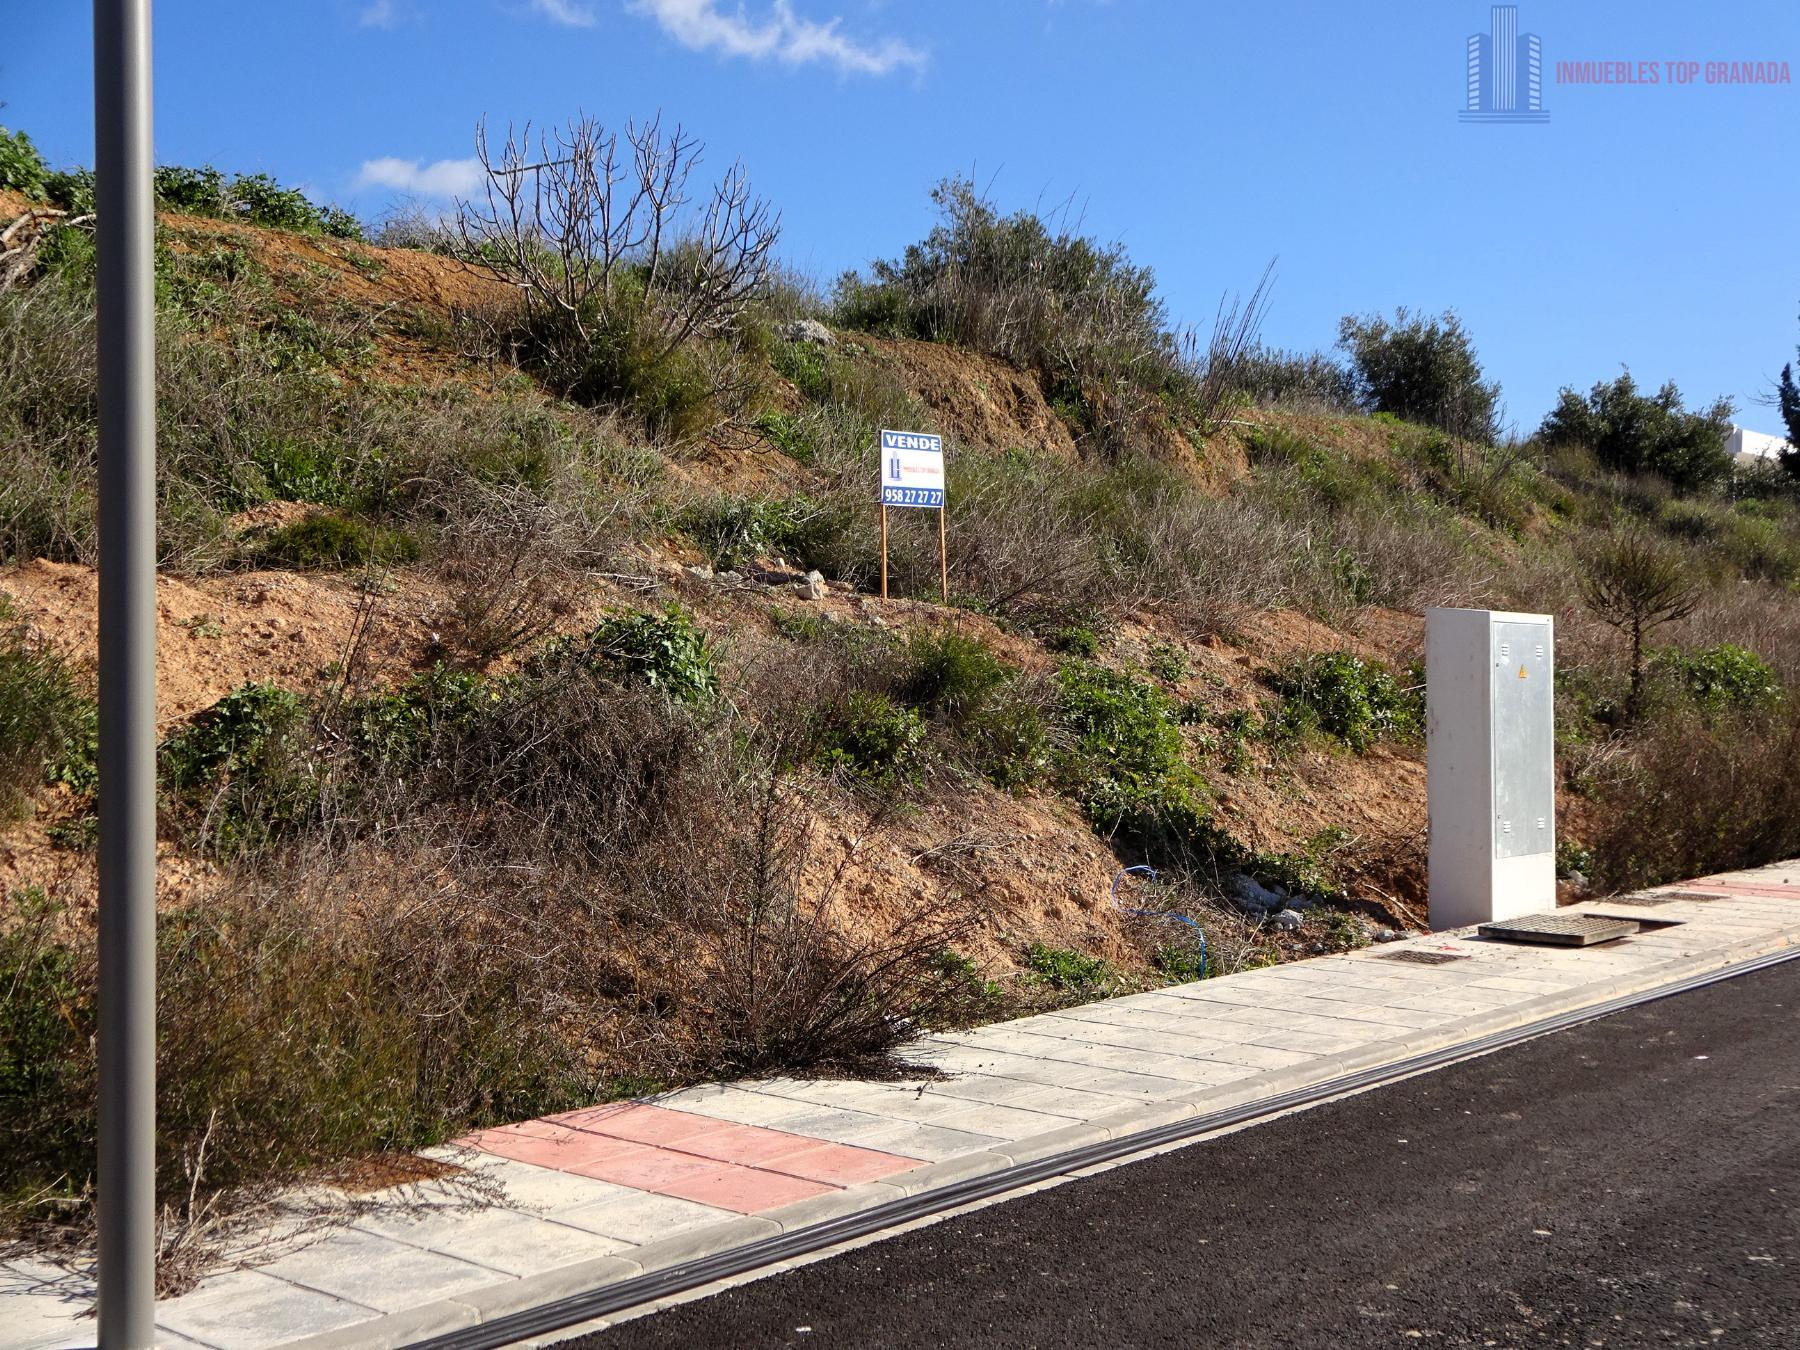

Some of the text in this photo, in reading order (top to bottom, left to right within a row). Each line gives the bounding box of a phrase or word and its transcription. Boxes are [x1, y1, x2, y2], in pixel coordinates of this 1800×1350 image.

[886, 435, 939, 450] VENDE
[885, 489, 942, 504] 958 27 27 27
